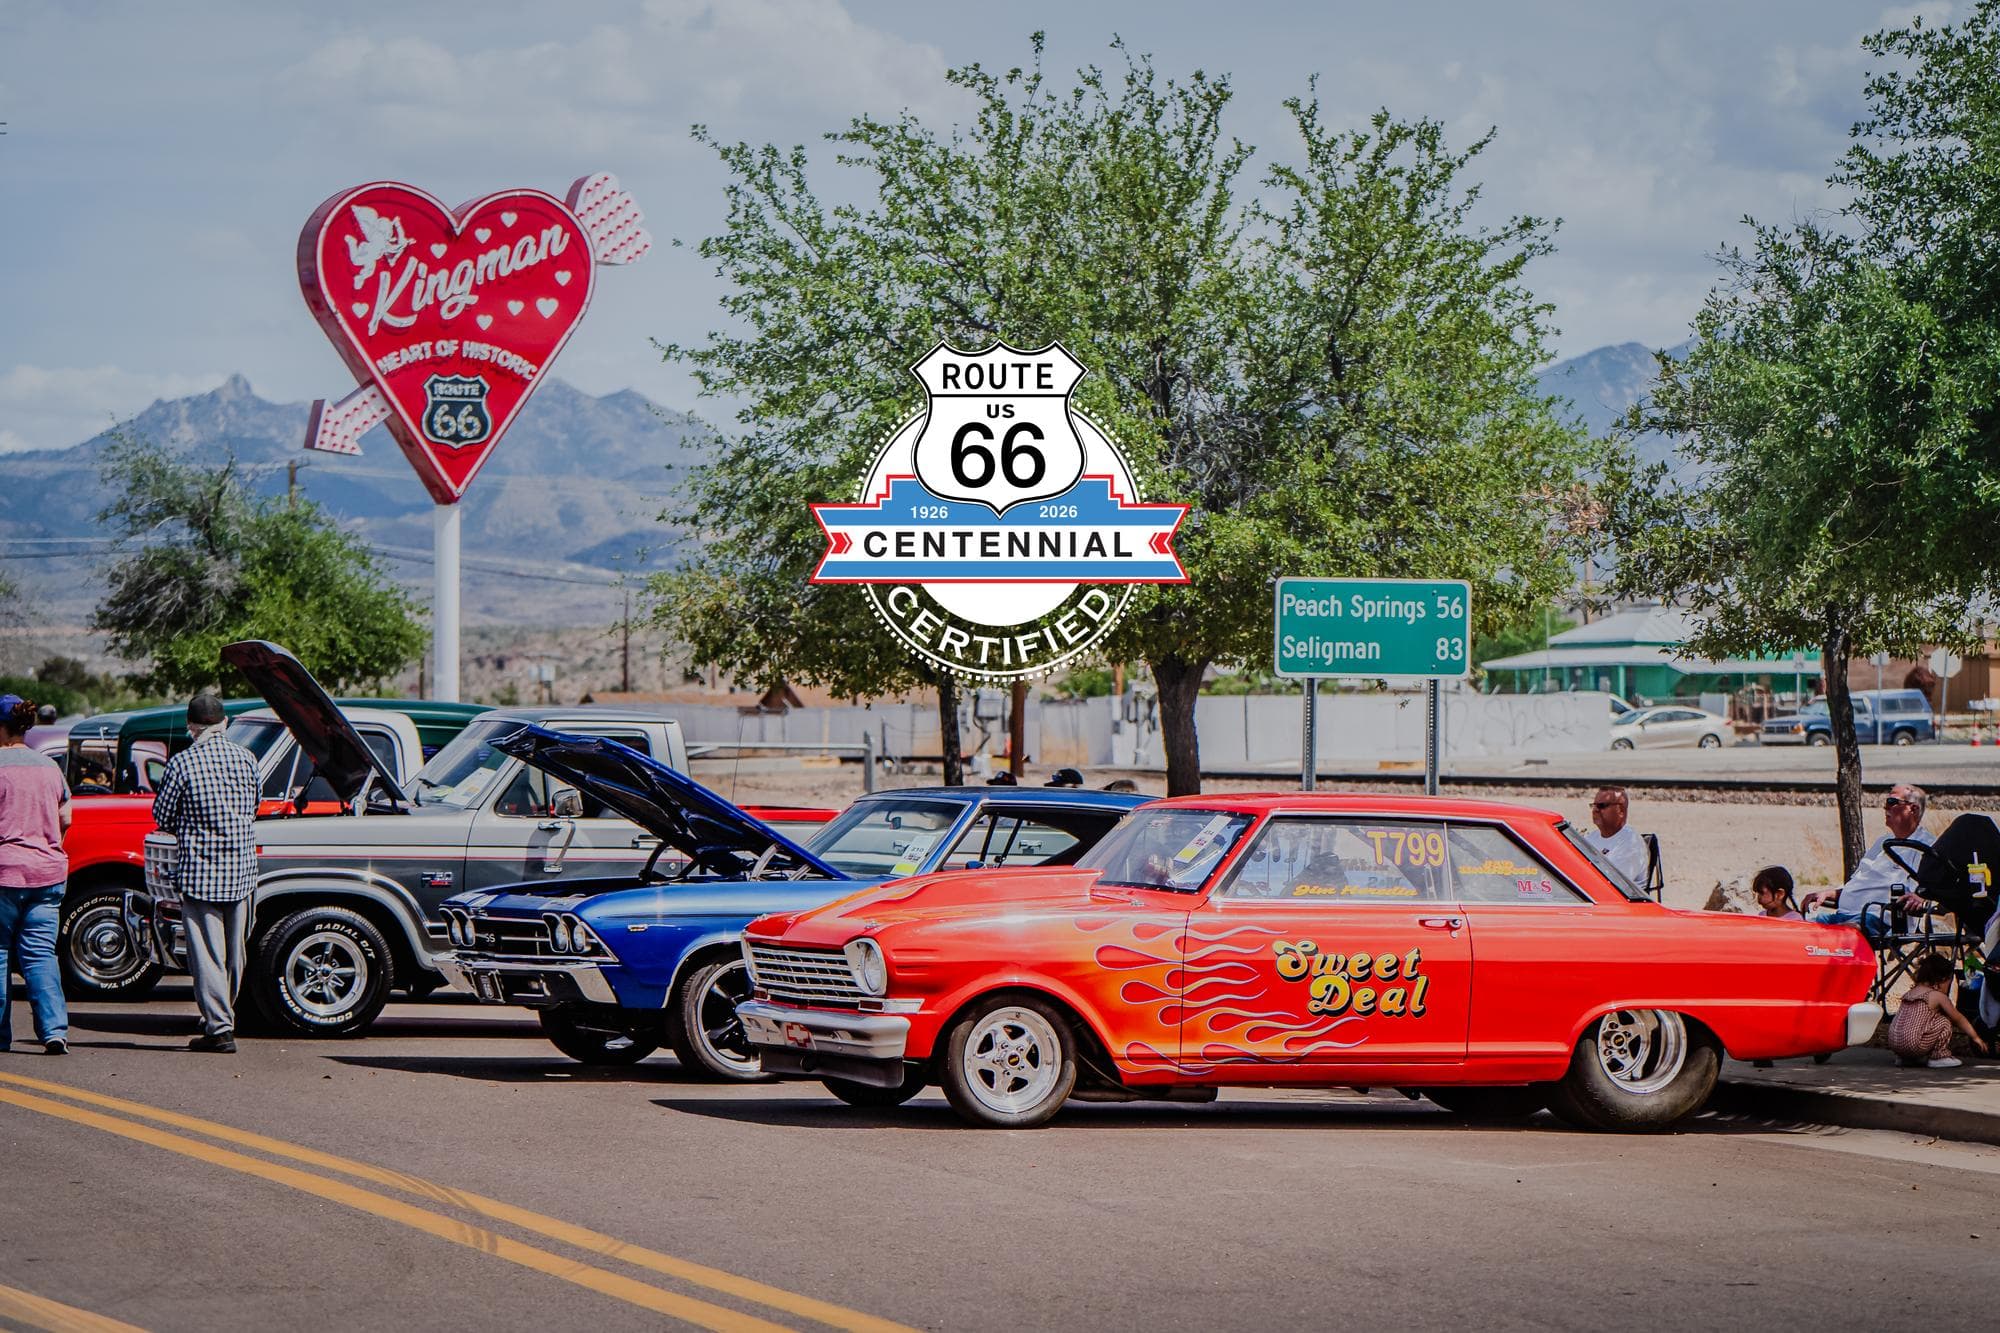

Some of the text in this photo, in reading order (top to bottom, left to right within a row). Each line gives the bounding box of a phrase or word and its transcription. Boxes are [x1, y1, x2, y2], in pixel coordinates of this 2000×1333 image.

[368, 224, 570, 336] Kingman
[376, 340, 538, 380] HEART OF HISTORIC
[433, 382, 481, 396] ROUTE
[432, 404, 482, 438] 66
[1282, 593, 1464, 625] Peach Springs 56
[1282, 635, 1463, 666] Seligman 83
[1366, 831, 1445, 867] T799
[314, 922, 359, 940] RADIAL
[1271, 940, 1424, 983] Sweet
[1307, 973, 1430, 1018] Deal
